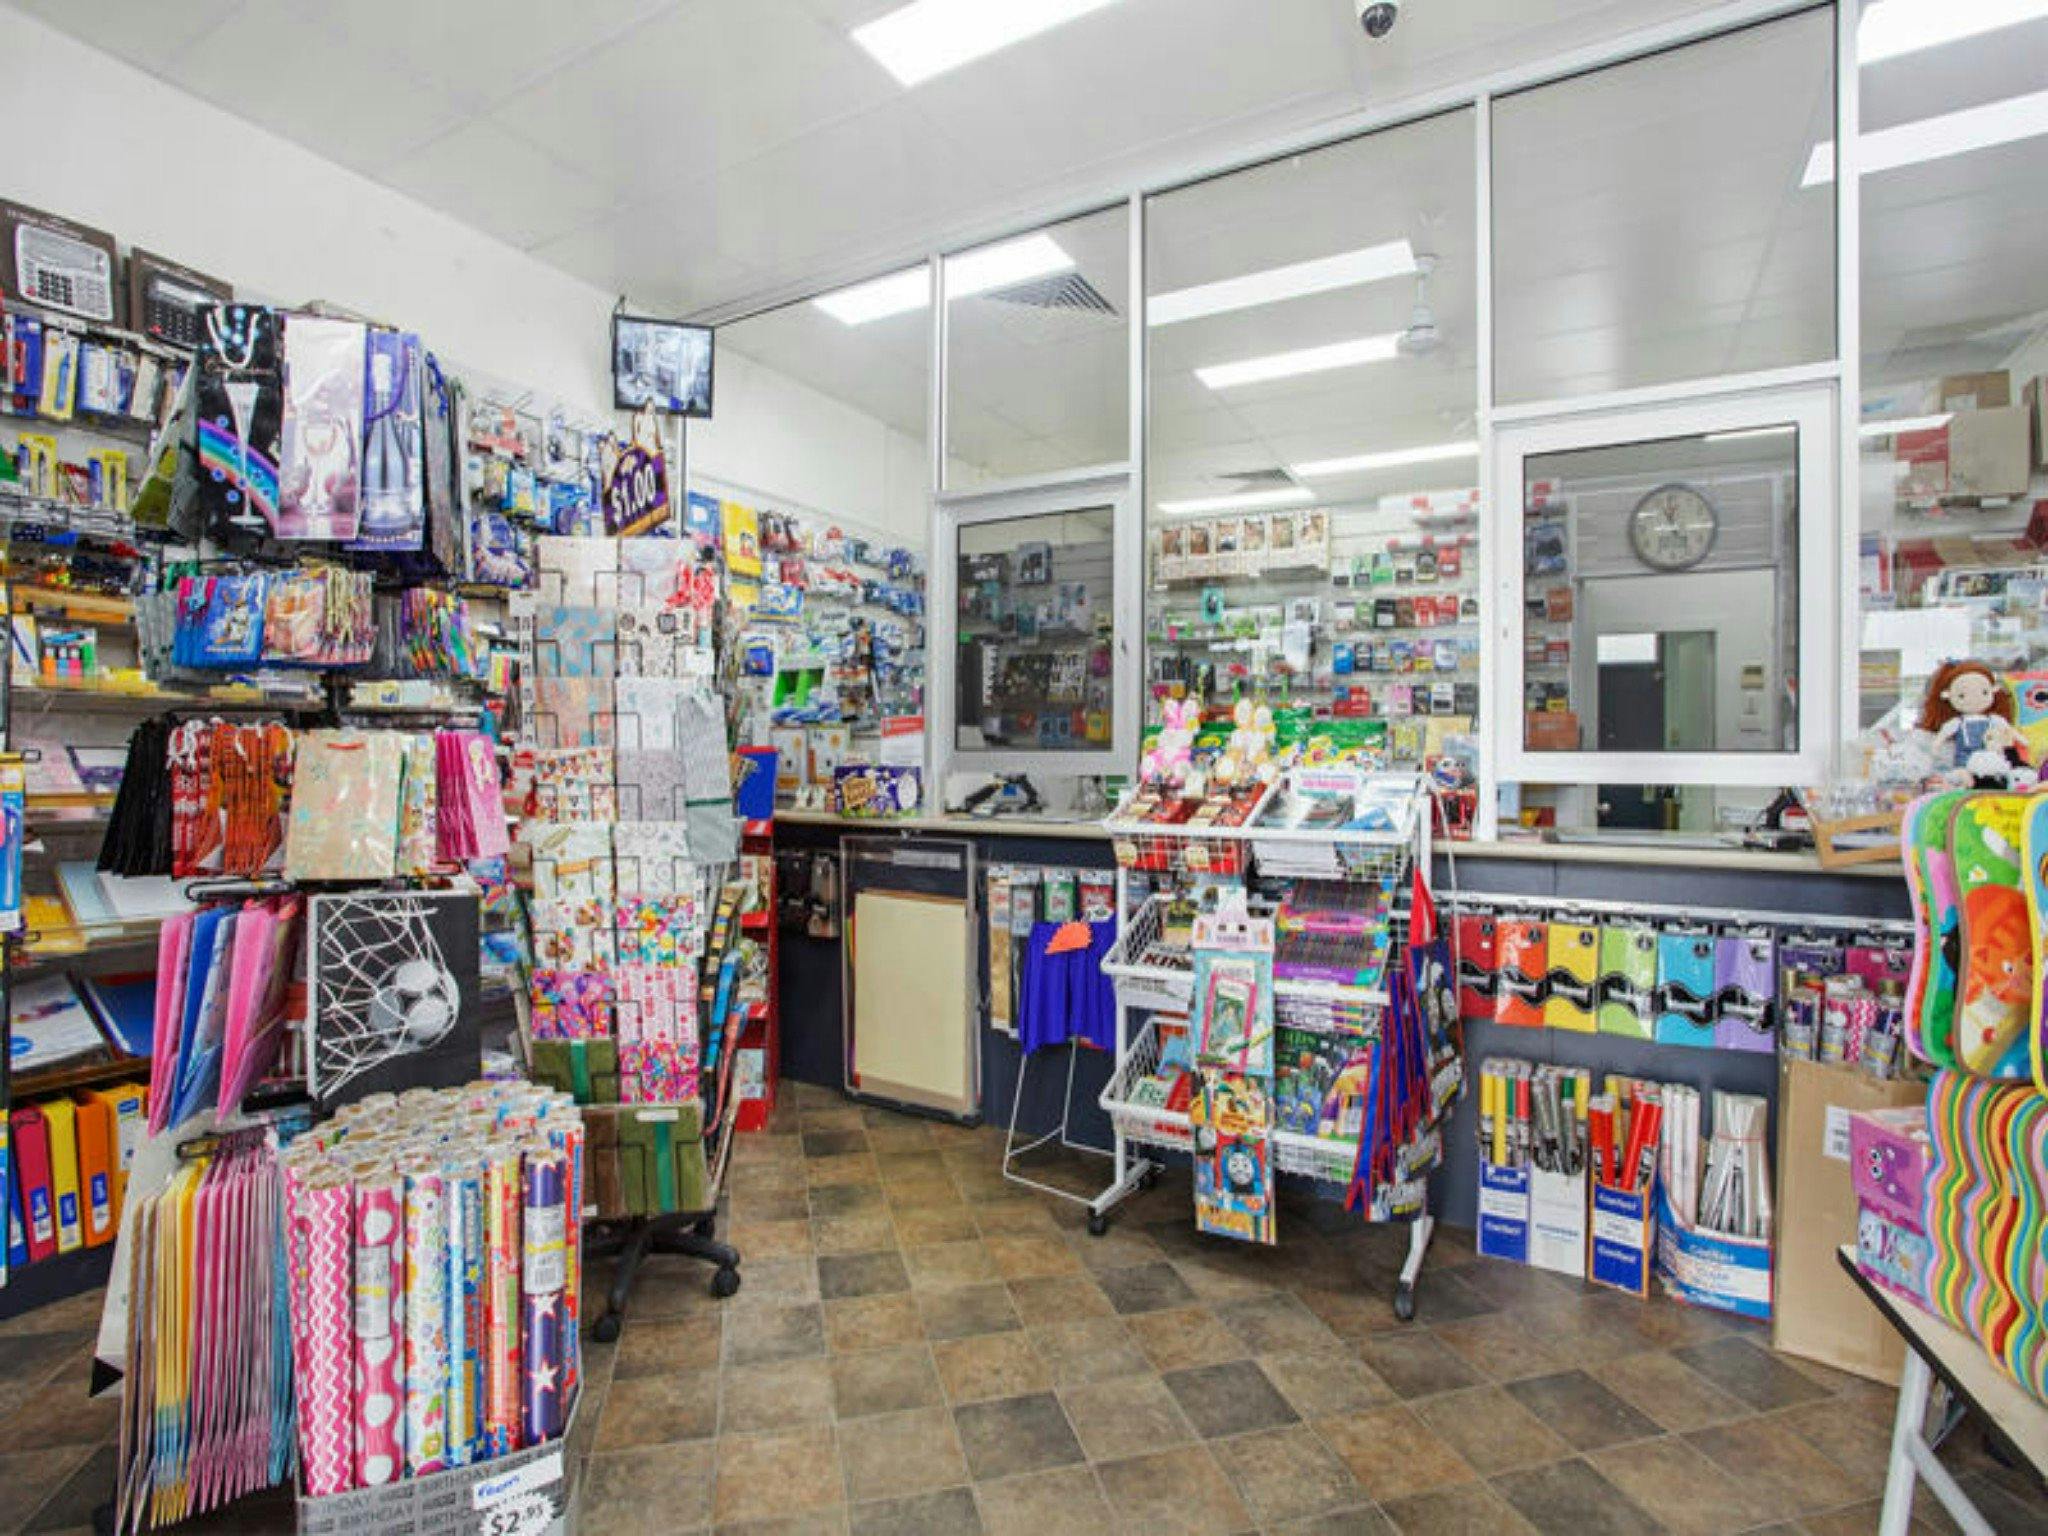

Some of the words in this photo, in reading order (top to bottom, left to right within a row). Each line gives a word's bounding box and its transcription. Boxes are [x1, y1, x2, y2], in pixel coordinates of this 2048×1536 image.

[611, 464, 656, 523] $1.00
[420, 1463, 493, 1493] BIRTHDAY
[340, 1501, 414, 1531] BIRTHDAY
